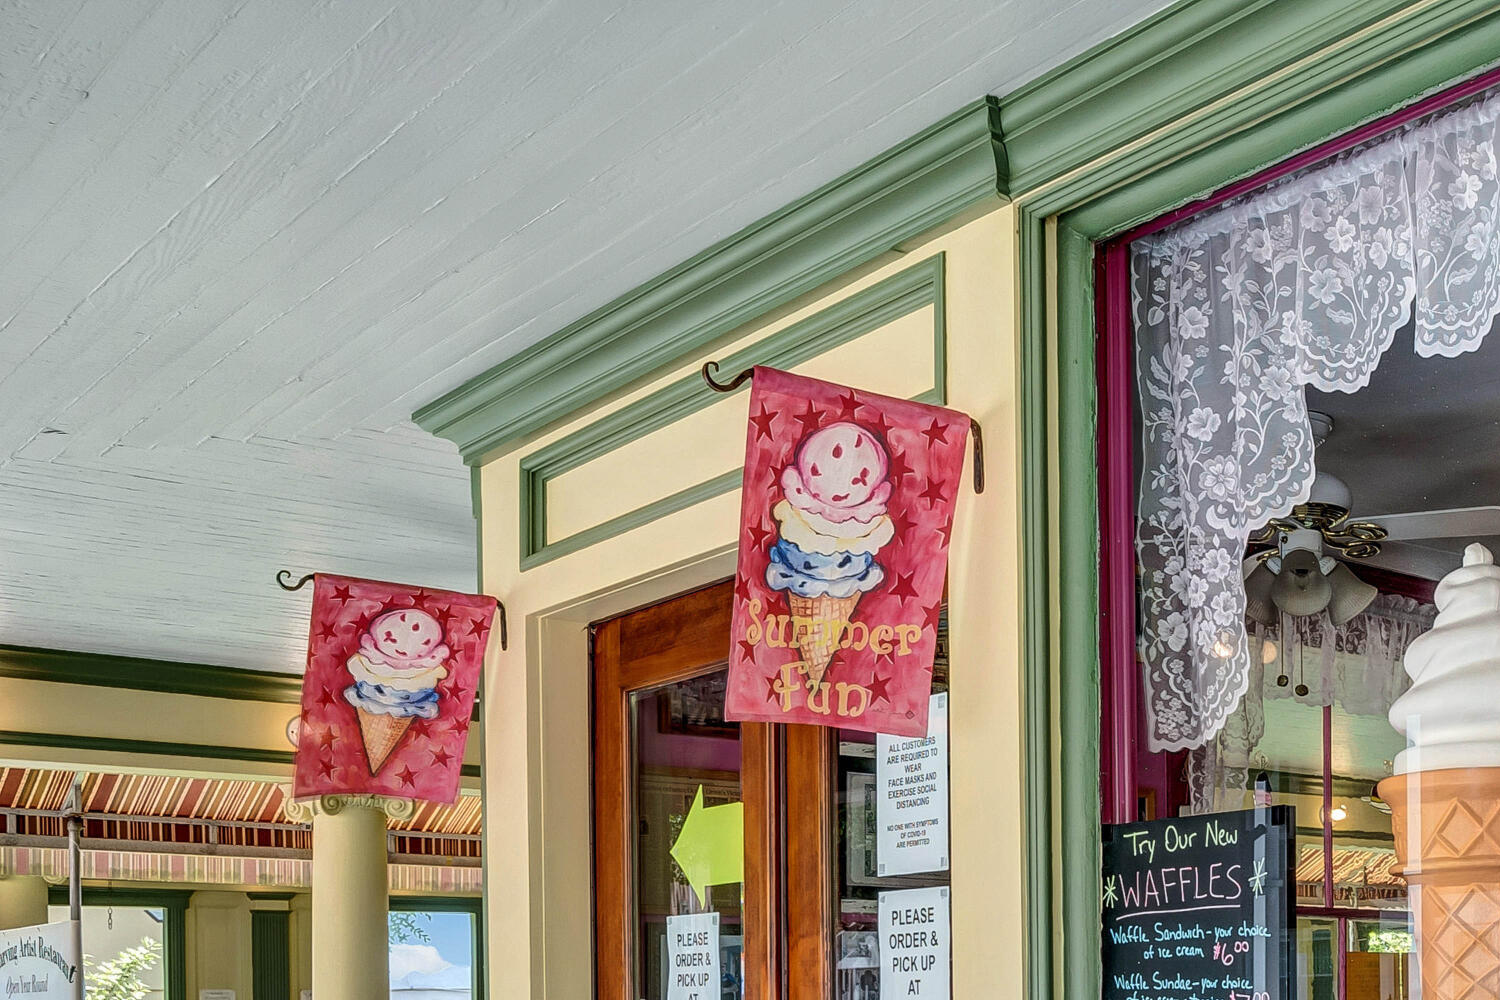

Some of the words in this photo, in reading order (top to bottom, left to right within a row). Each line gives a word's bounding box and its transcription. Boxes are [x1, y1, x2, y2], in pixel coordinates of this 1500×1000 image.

[746, 598, 922, 655] Summer
[773, 661, 866, 717] Fun
[889, 744, 900, 753] ALL
[902, 736, 935, 750] CUSTOMERS
[887, 755, 899, 764] ARE
[901, 750, 929, 762] REQUIRED
[931, 748, 937, 756] TO
[905, 763, 921, 773] WEAR
[888, 778, 903, 787] FACE
[905, 774, 924, 785] MASKS
[926, 772, 937, 781] AND
[888, 787, 916, 799] EXERCISE
[917, 784, 937, 793] SOCIAL
[896, 797, 929, 809] DISTANCING
[1123, 830, 1155, 863] Try
[1165, 825, 1197, 851] Our
[1205, 820, 1238, 847] New
[891, 907, 934, 926] PLEASE
[677, 932, 708, 947] PLEASE
[889, 931, 928, 949] ORDER
[931, 931, 939, 946] &
[1110, 925, 1149, 945] Waffle
[1238, 921, 1271, 937] choice
[20, 937, 37, 958] Artist
[1144, 946, 1154, 959] of
[1158, 946, 1172, 958] ice
[1176, 943, 1204, 957] cream
[675, 952, 702, 968] ORDER
[705, 953, 711, 966] &
[892, 956, 918, 972] PICK
[921, 955, 935, 970] UP
[677, 973, 696, 987] PICK
[698, 973, 709, 987] UP
[907, 979, 920, 995] AT
